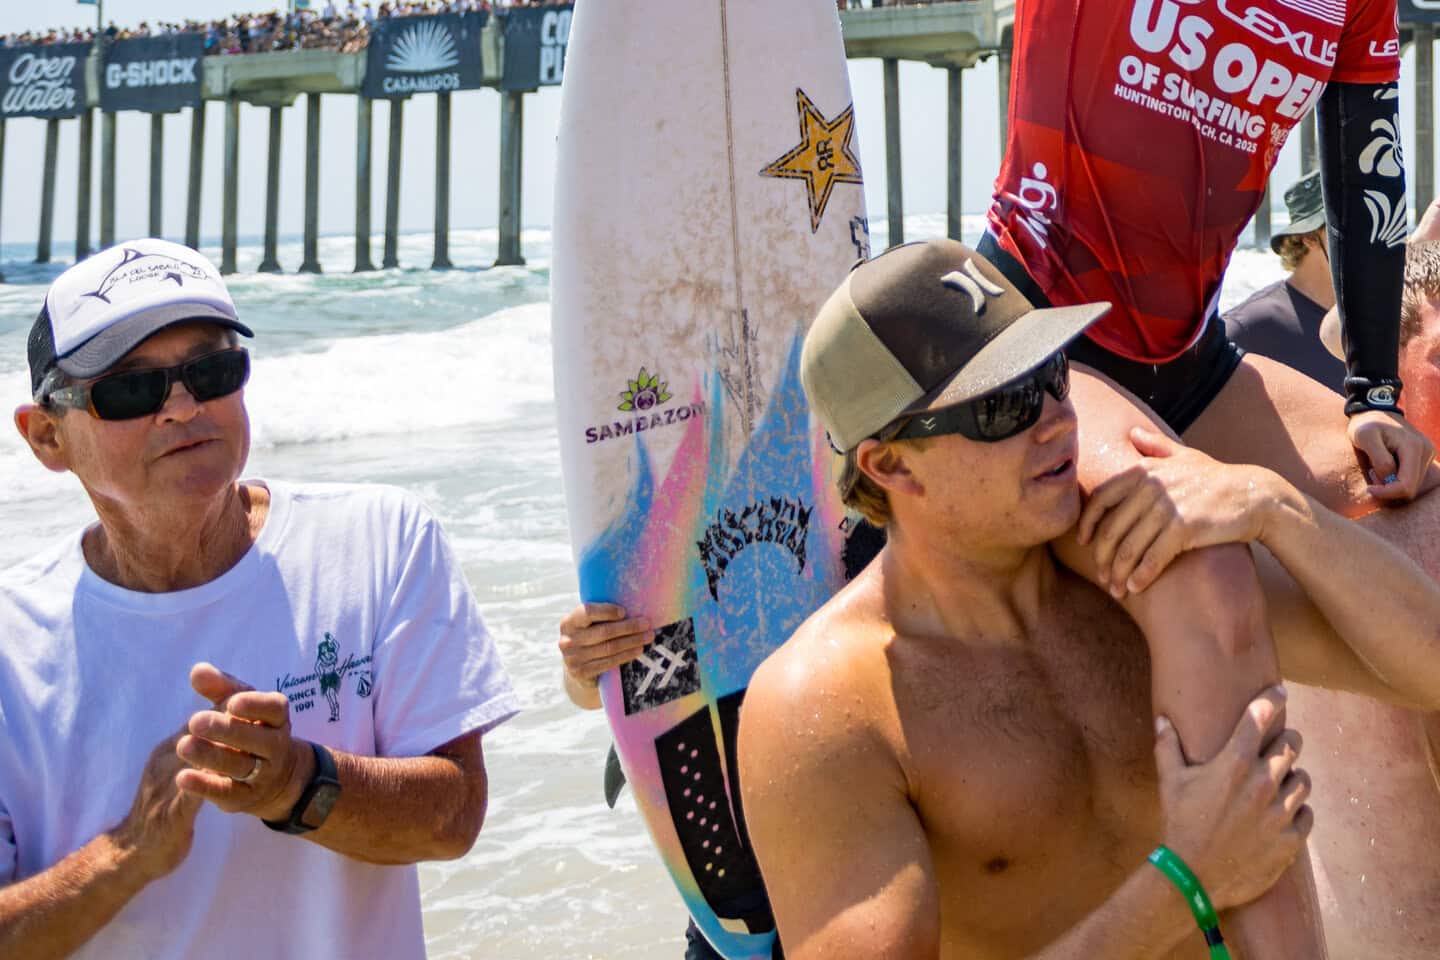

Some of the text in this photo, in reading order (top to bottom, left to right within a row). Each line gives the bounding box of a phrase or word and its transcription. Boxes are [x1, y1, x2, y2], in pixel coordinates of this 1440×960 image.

[8, 53, 77, 86] Open
[106, 58, 198, 89] G-SHOCK
[383, 72, 460, 92] CASAMIGOS
[1212, 42, 1331, 123] OPEN
[1, 79, 76, 113] Water
[1119, 55, 1161, 91] OF
[1162, 73, 1267, 139] SURFING
[1114, 83, 1258, 154] HUNTINGTON BCH, CA 2025
[288, 687, 317, 703] SINCE
